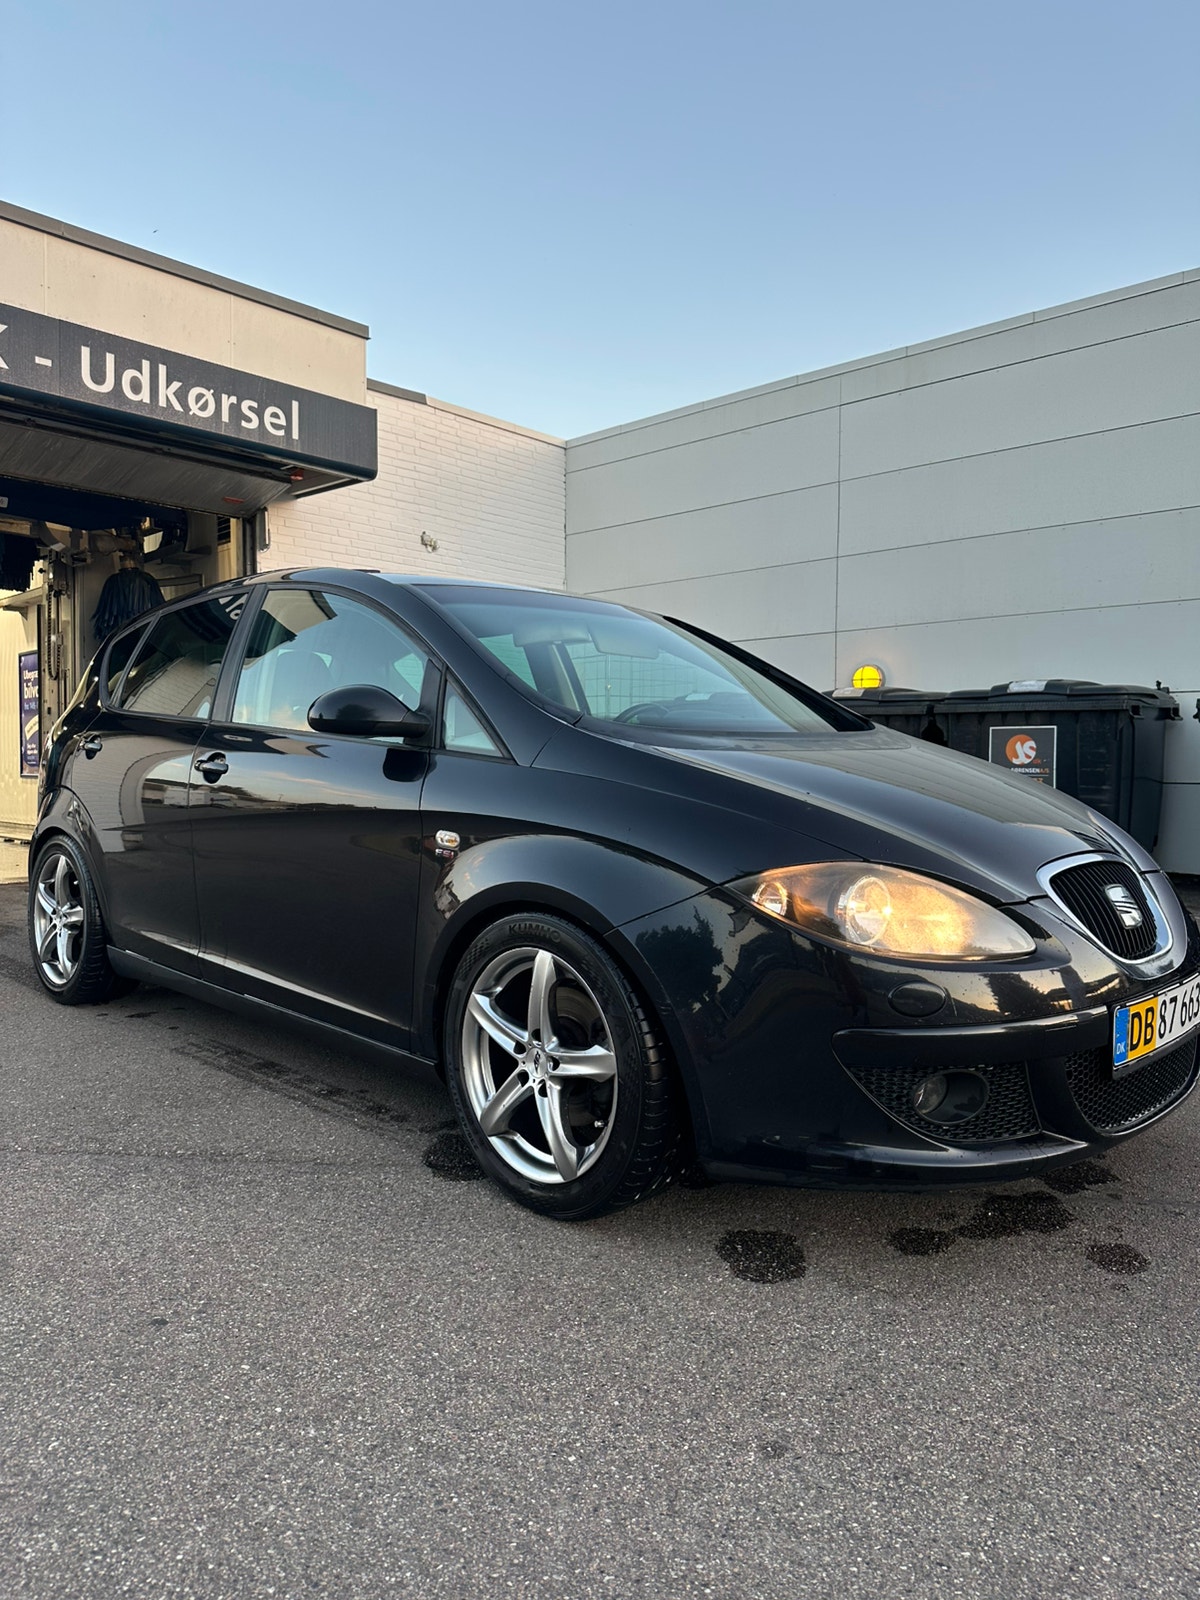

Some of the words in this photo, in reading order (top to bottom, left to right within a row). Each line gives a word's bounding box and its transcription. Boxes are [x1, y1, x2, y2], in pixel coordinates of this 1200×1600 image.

[81, 345, 299, 440] Udkørsel
[508, 922, 561, 943] KUMHO
[1130, 1006, 1155, 1052] DB
[1158, 995, 1178, 1039] 87
[1116, 1042, 1126, 1055] DK
